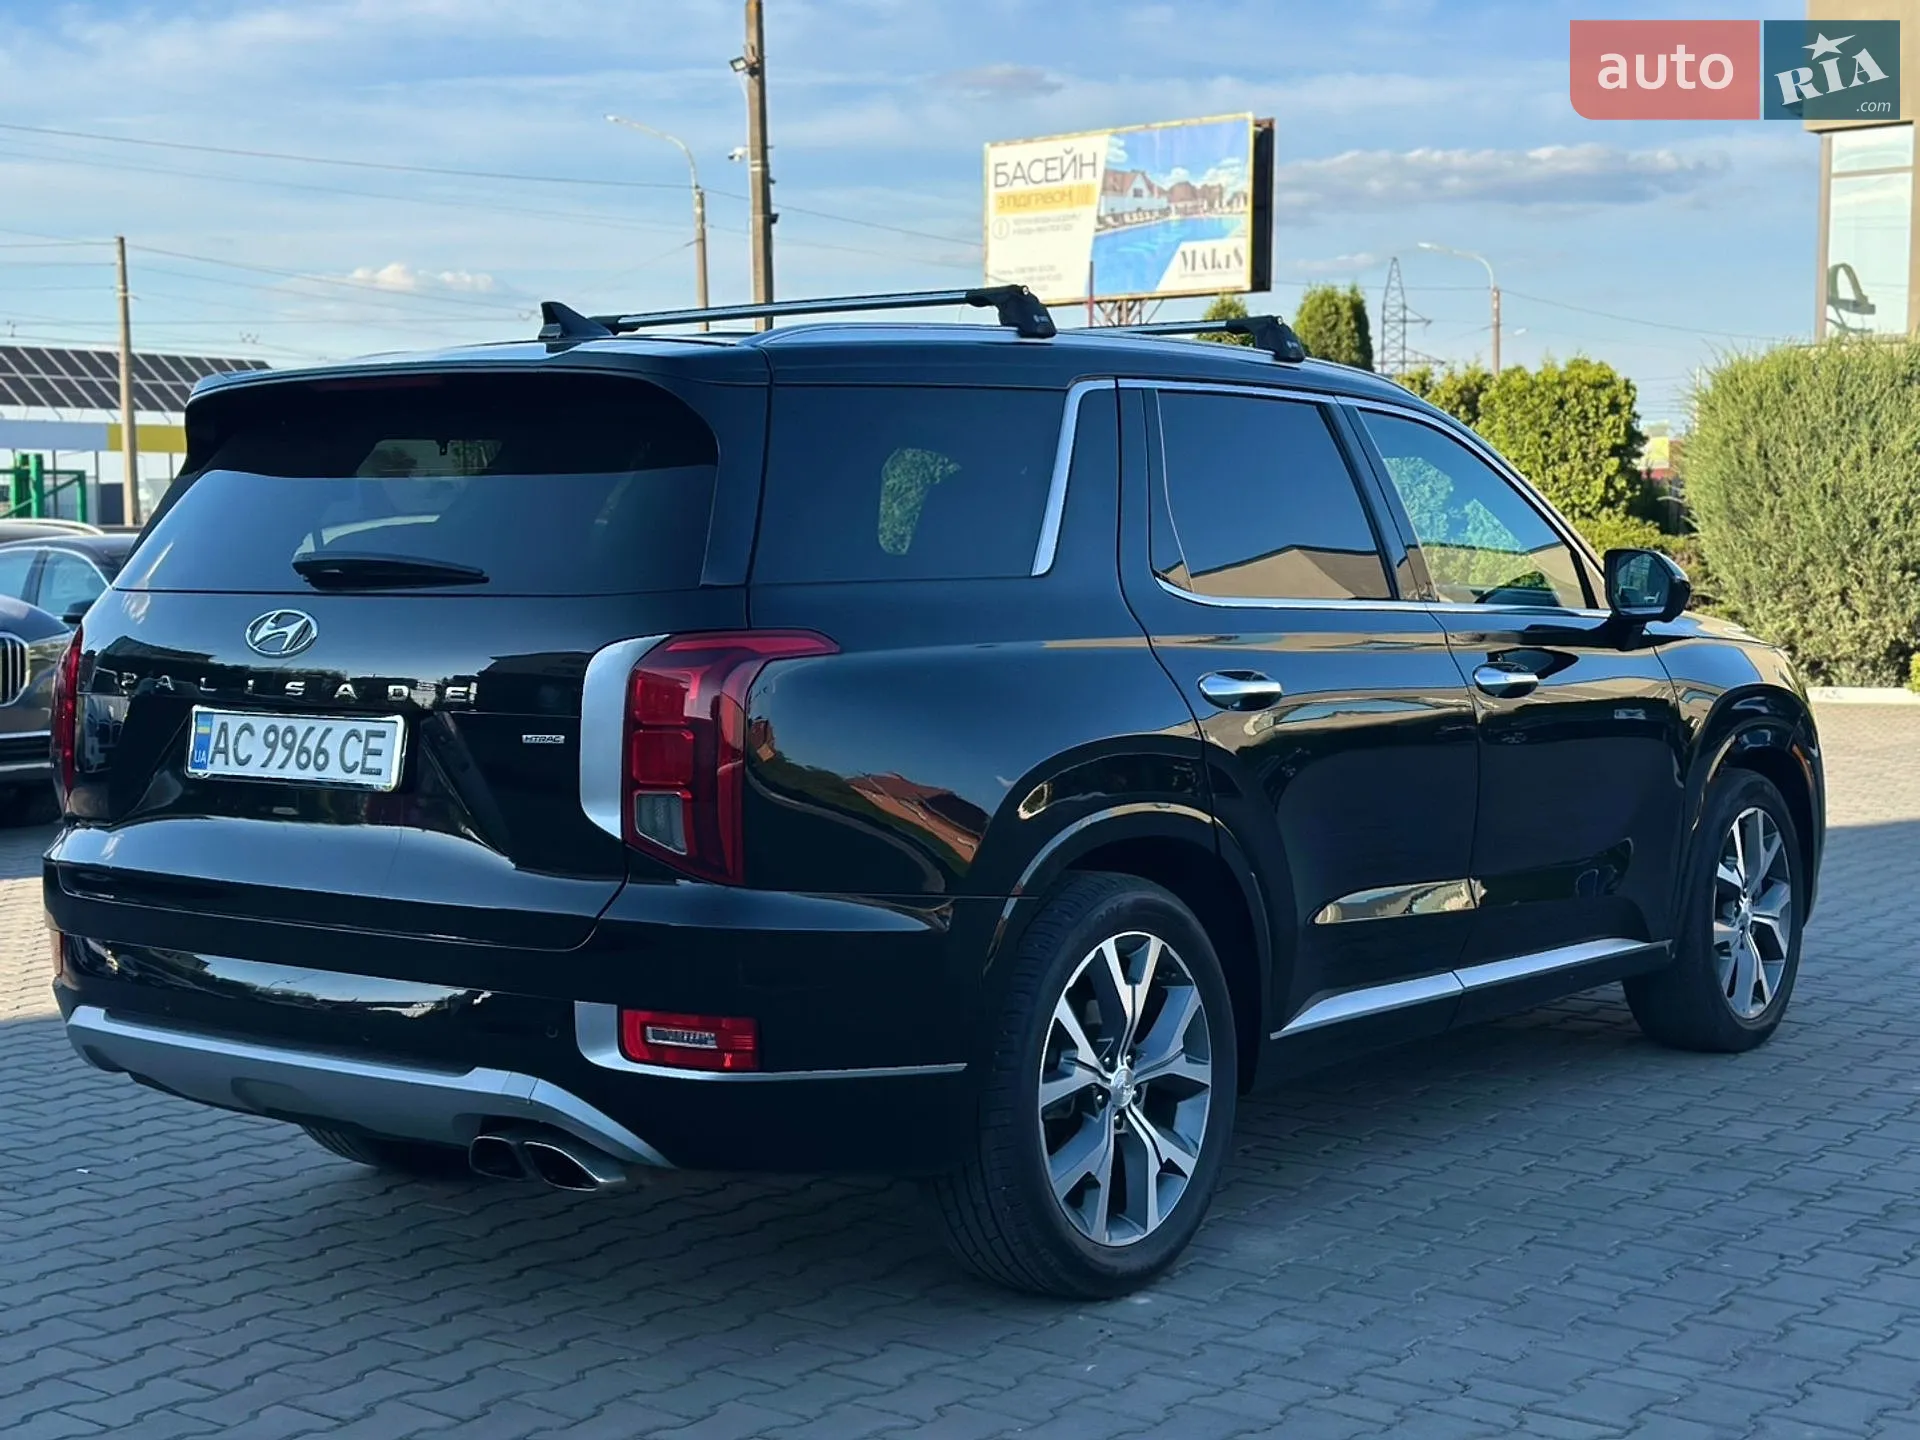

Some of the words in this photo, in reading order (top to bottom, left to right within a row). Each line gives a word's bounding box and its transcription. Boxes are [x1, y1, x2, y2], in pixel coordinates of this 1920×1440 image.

[994, 147, 1096, 188] БАСЕЙН
[121, 671, 475, 701] PALISADE
[209, 721, 255, 767] AC
[260, 723, 333, 772] 9966
[338, 728, 387, 776] CE
[523, 735, 564, 743] HTRAC
[194, 753, 207, 764] UA
